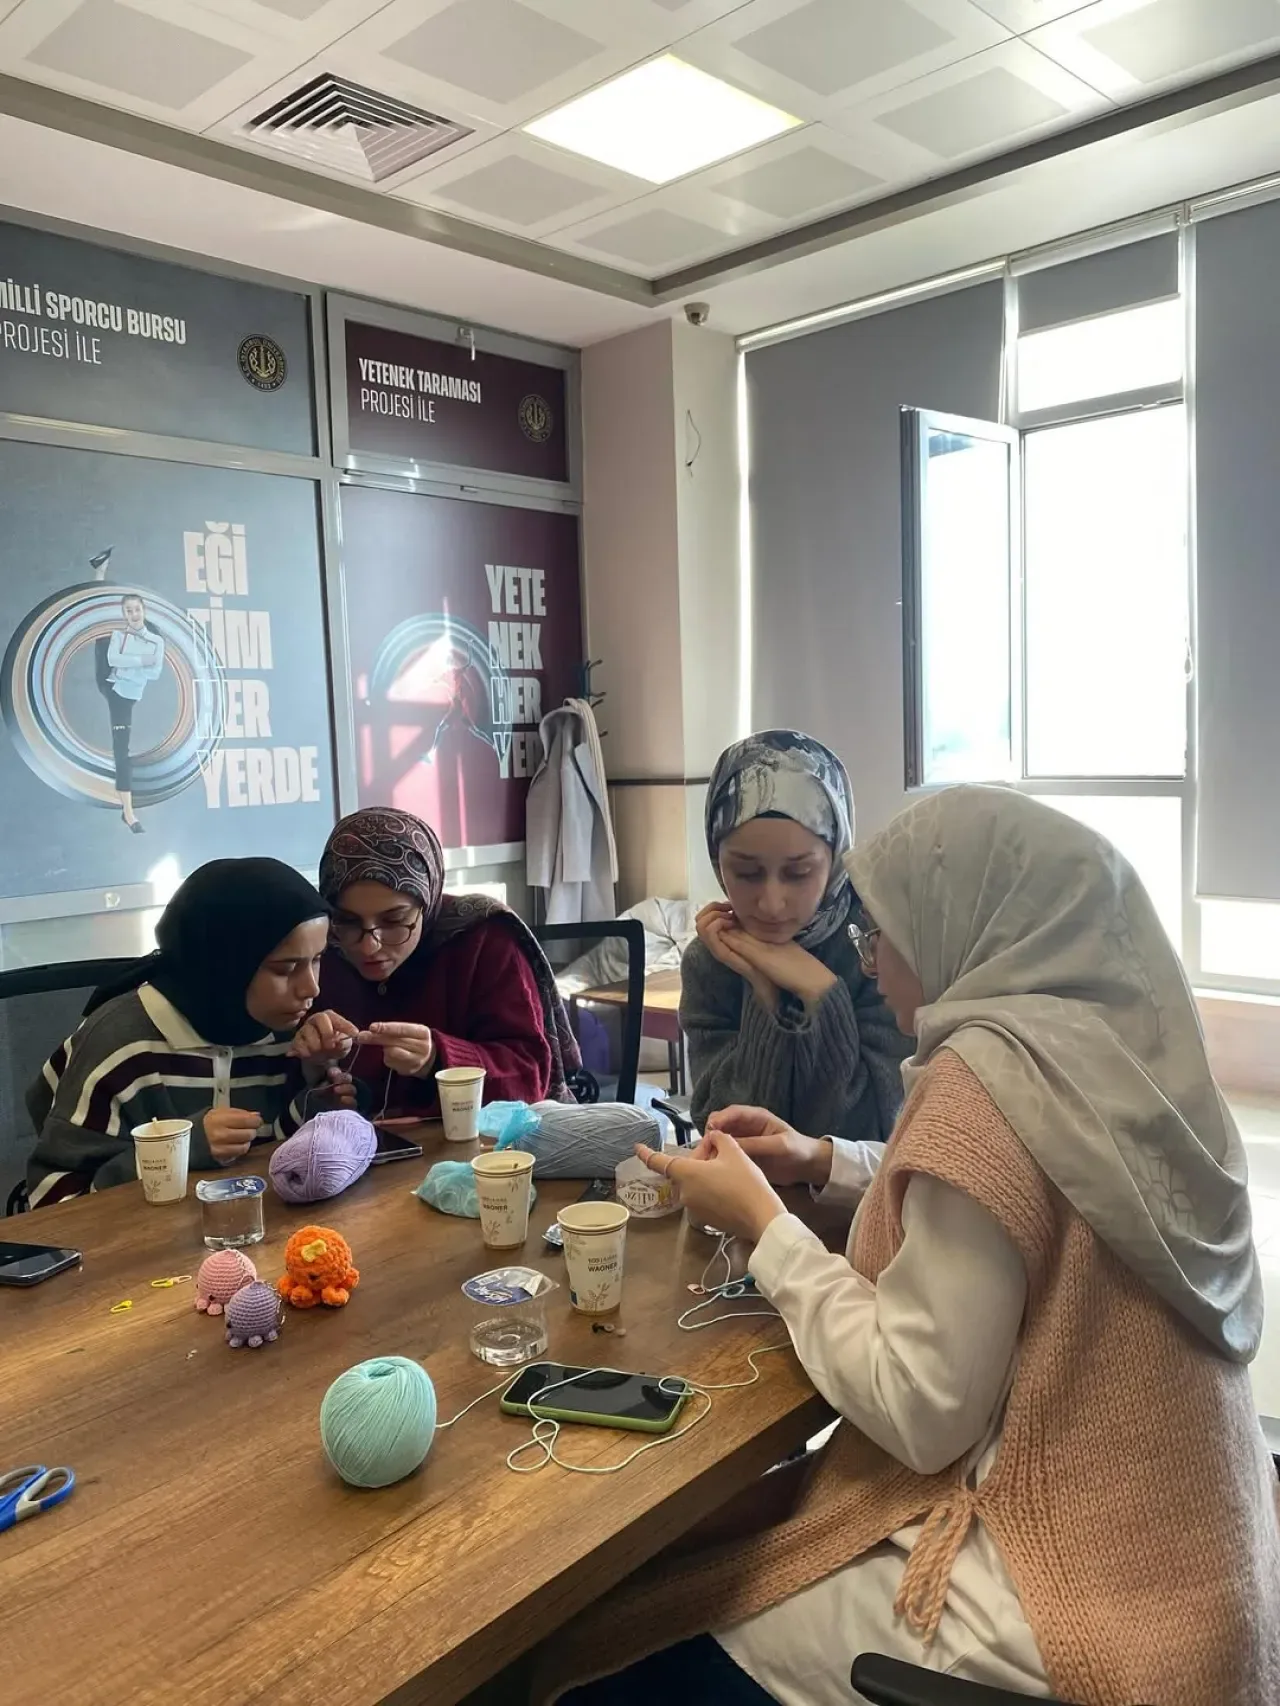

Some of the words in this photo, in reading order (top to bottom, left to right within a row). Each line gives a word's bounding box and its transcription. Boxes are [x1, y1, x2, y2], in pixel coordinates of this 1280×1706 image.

[0, 320, 69, 359] ROJESİ
[76, 331, 102, 365] İLE
[45, 291, 122, 333] SPORCU
[127, 308, 187, 345] BURSU
[358, 357, 415, 391] YETENEK
[417, 369, 481, 404] TARAMASI
[360, 388, 414, 419] PROJESİ
[418, 395, 436, 423] İLE
[183, 521, 249, 596] EĞİ
[484, 564, 546, 616] YETE
[187, 597, 273, 669] TİM
[487, 621, 544, 670] NEK
[192, 679, 272, 738] HER
[490, 676, 543, 725] HER
[196, 746, 320, 809] YERDE
